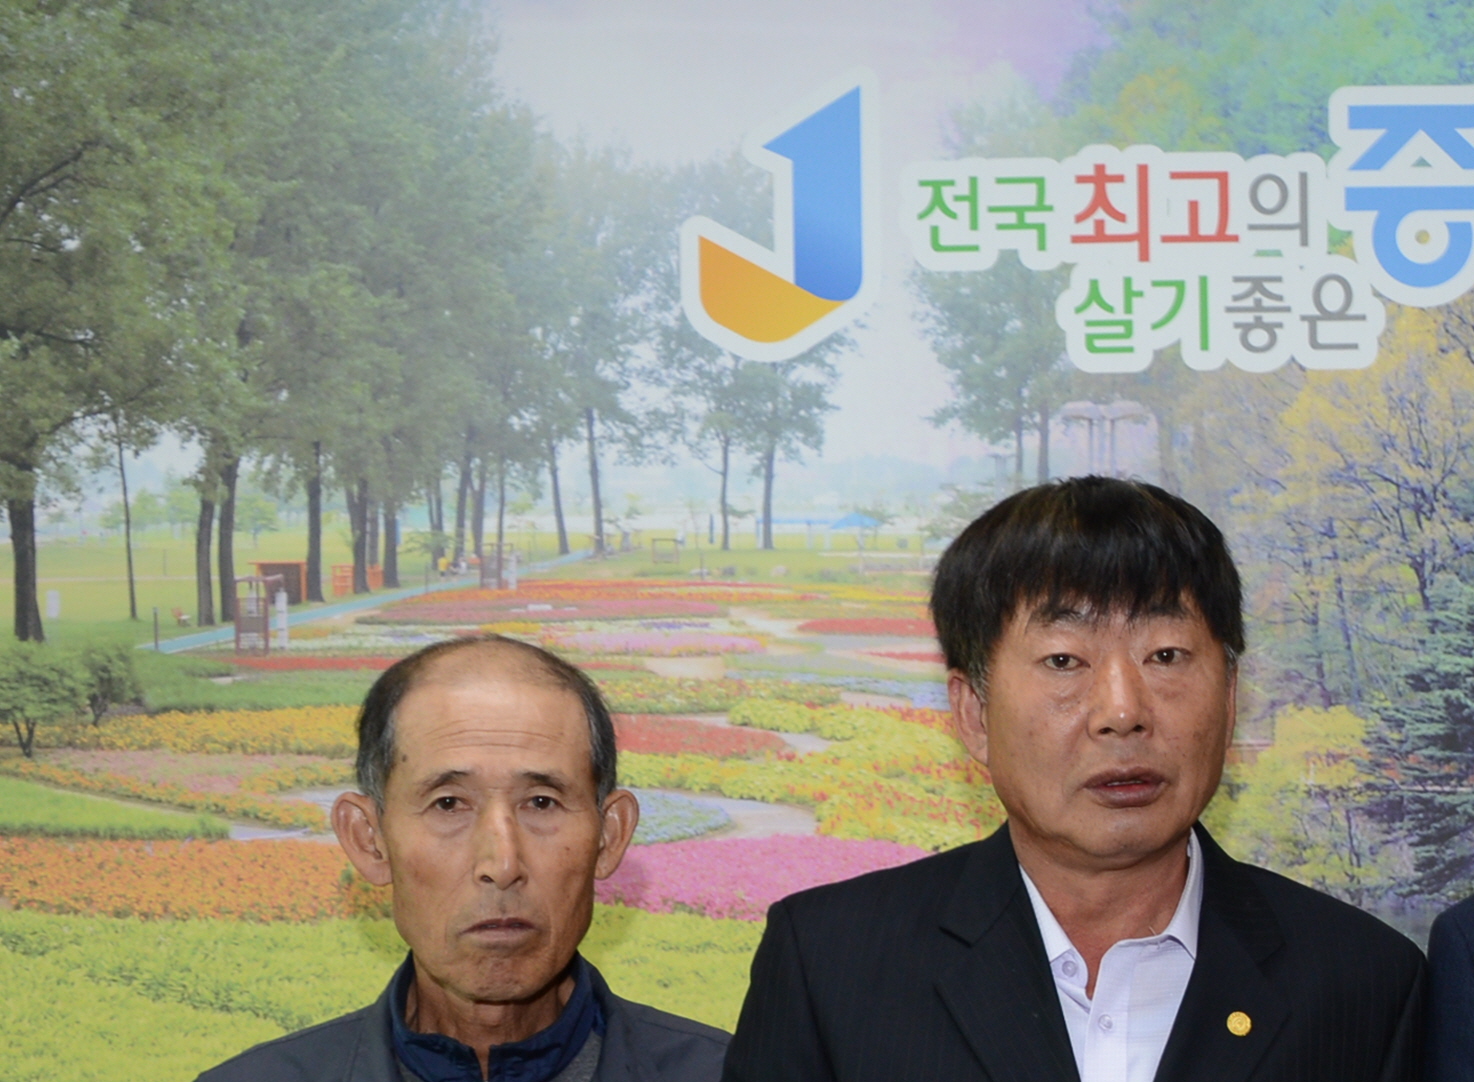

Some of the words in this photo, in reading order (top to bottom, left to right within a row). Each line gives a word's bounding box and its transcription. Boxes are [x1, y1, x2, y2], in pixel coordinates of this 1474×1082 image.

[917, 176, 1054, 252] 전국
[1070, 163, 1309, 262] 최고의
[1074, 275, 1210, 354] 살기
[1225, 275, 1367, 354] 좋은
